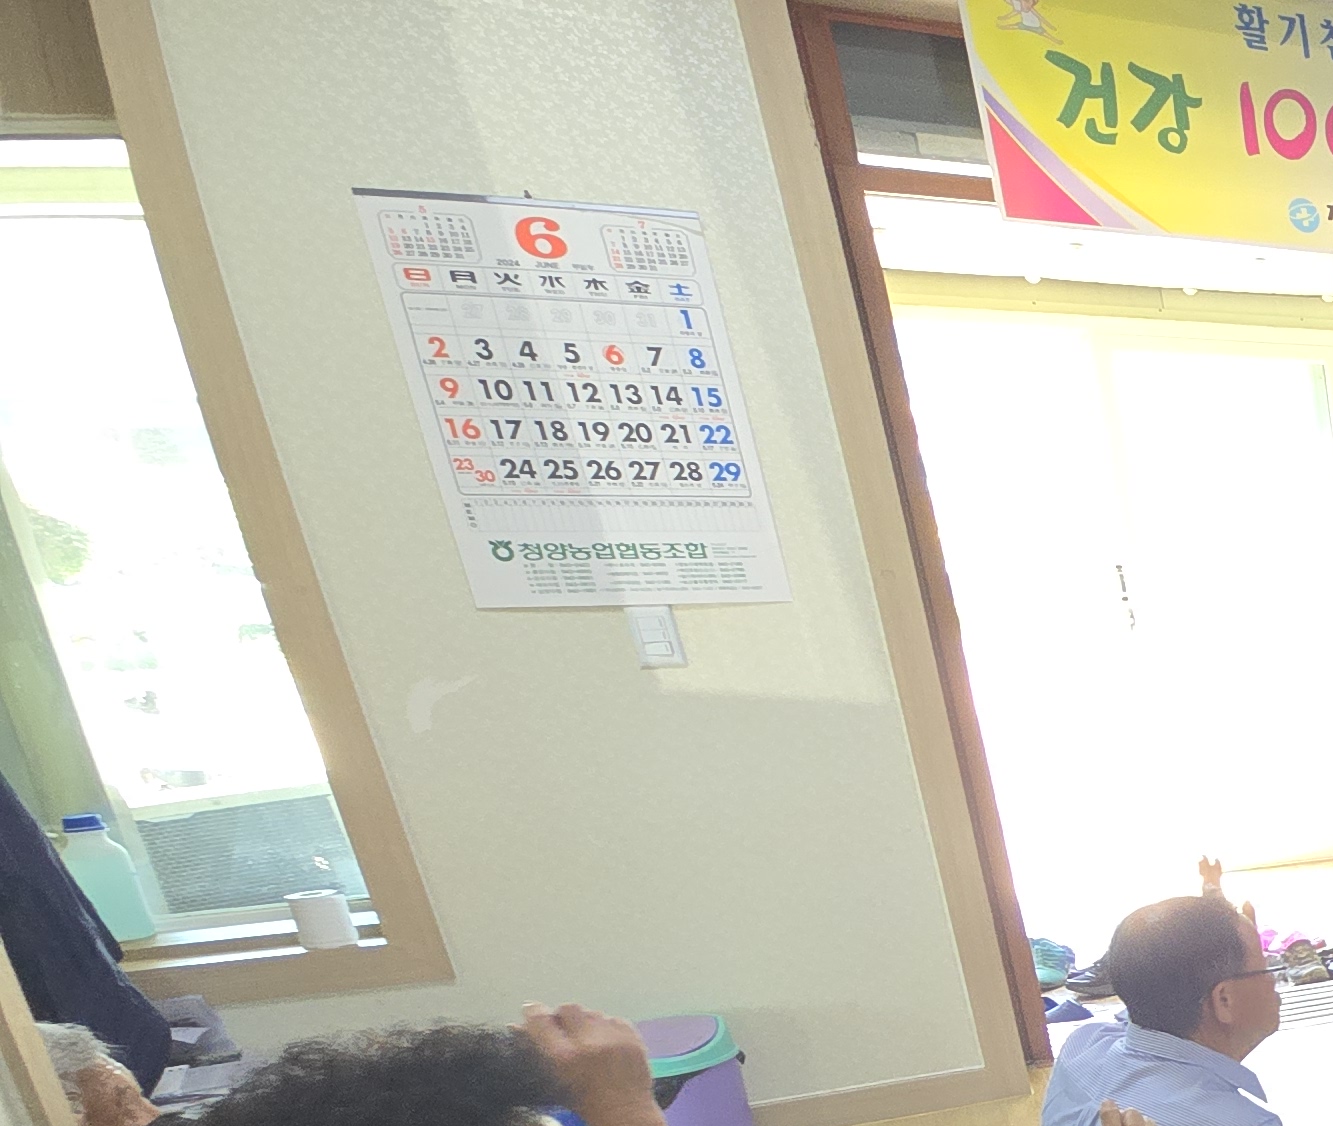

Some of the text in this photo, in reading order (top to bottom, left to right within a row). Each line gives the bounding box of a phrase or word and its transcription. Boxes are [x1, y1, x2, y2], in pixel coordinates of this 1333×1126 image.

[1045, 50, 1202, 154] 건강
[515, 216, 568, 259] 6
[497, 259, 559, 269] 2024 JUNE
[403, 268, 693, 296] 日 月 火 水 木 金 土
[680, 310, 693, 329] 1
[428, 336, 450, 358] 2
[474, 338, 493, 360] 3
[519, 340, 538, 361] 4
[564, 342, 581, 363] 5
[604, 344, 625, 365] 6
[646, 346, 663, 367] 7
[689, 348, 706, 369] 8
[439, 377, 459, 398] 9
[478, 378, 513, 400] 10
[522, 380, 554, 401] 11
[566, 382, 602, 403] 12
[609, 384, 643, 404] 13
[650, 385, 683, 406] 14
[691, 387, 723, 407] 15
[444, 418, 734, 445] 16 17 18 19 20 21 22
[453, 458, 741, 482] 23 24 25 26 27 28 29
[474, 470, 496, 482] 30
[517, 542, 708, 561] 청양농업협동조합
